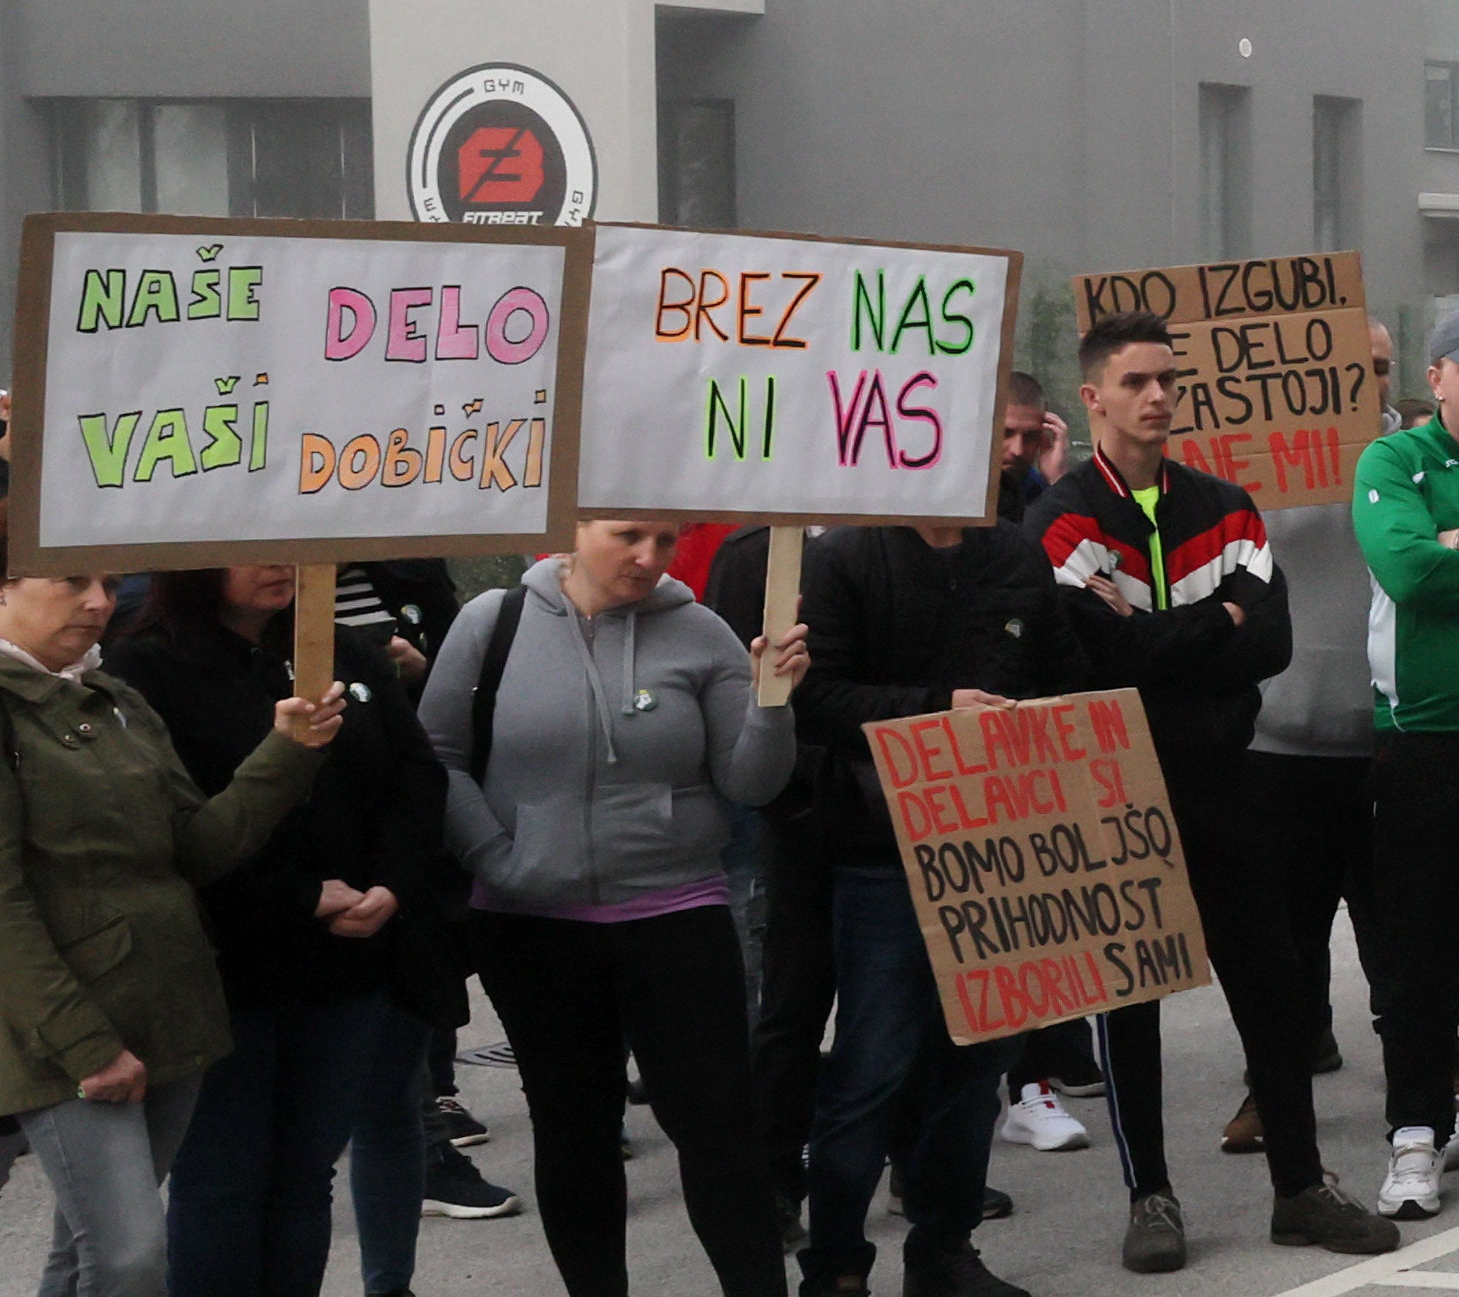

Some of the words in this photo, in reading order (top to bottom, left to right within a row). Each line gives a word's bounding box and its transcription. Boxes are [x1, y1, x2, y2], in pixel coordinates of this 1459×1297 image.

[484, 79, 525, 95] GYM
[77, 244, 263, 335] NAŠE
[324, 285, 549, 364] DELO
[653, 265, 824, 352] BREZ
[849, 267, 977, 357] NAS
[1084, 270, 1177, 328] KDO
[1211, 318, 1333, 374] DELO
[297, 388, 548, 496] DOBIČKI
[704, 374, 777, 462] NI
[825, 369, 944, 471] VAS
[1268, 426, 1343, 494] MI!
[874, 703, 1088, 789] DELAVKE
[1087, 699, 1131, 754] IN
[896, 767, 1068, 842] DELAVCI
[1088, 758, 1128, 809] SI
[913, 835, 1025, 902] BOMO
[938, 876, 1163, 964] PRIHODNOST
[955, 949, 1109, 1034] IZBORILI
[1102, 932, 1193, 998] SAMI
